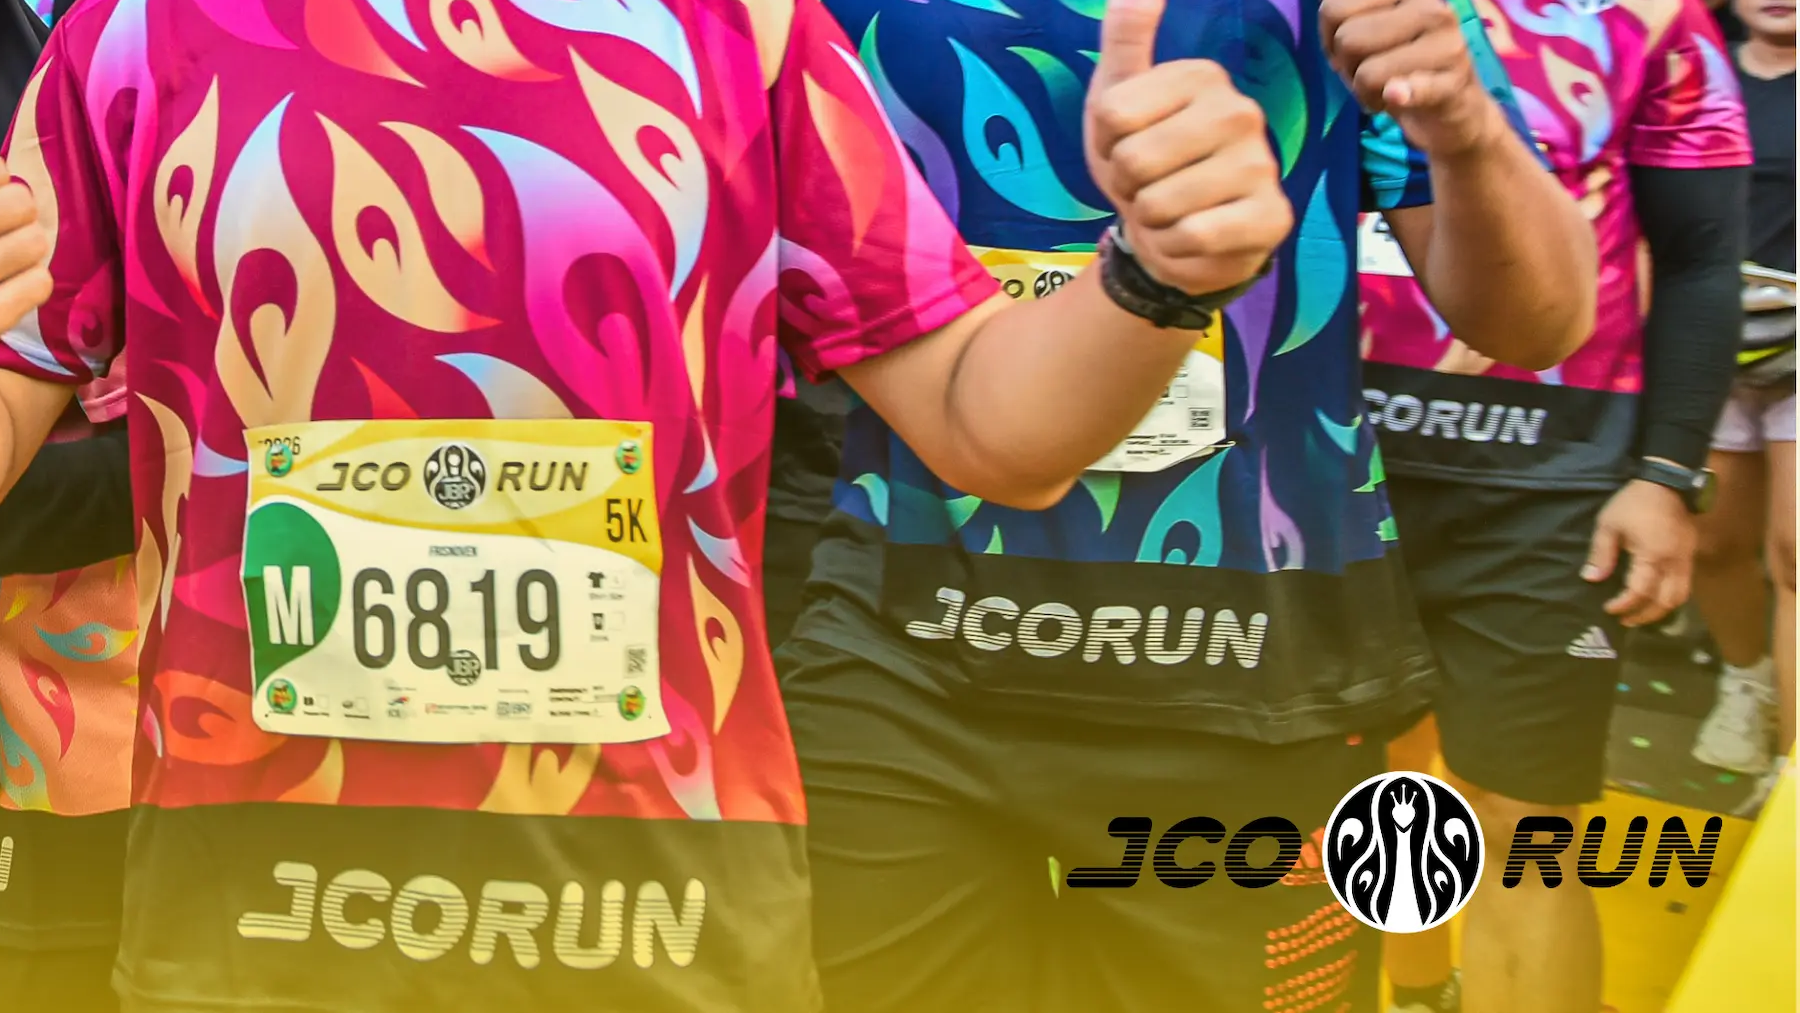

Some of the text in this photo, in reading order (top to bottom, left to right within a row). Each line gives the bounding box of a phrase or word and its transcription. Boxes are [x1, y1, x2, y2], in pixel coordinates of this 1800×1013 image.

[316, 461, 590, 493] JCO RUN
[606, 497, 648, 544] 5K
[263, 565, 314, 647] M
[353, 566, 561, 672] 6819
[905, 586, 1269, 669] JCORUN
[237, 860, 707, 970] JCORUN
